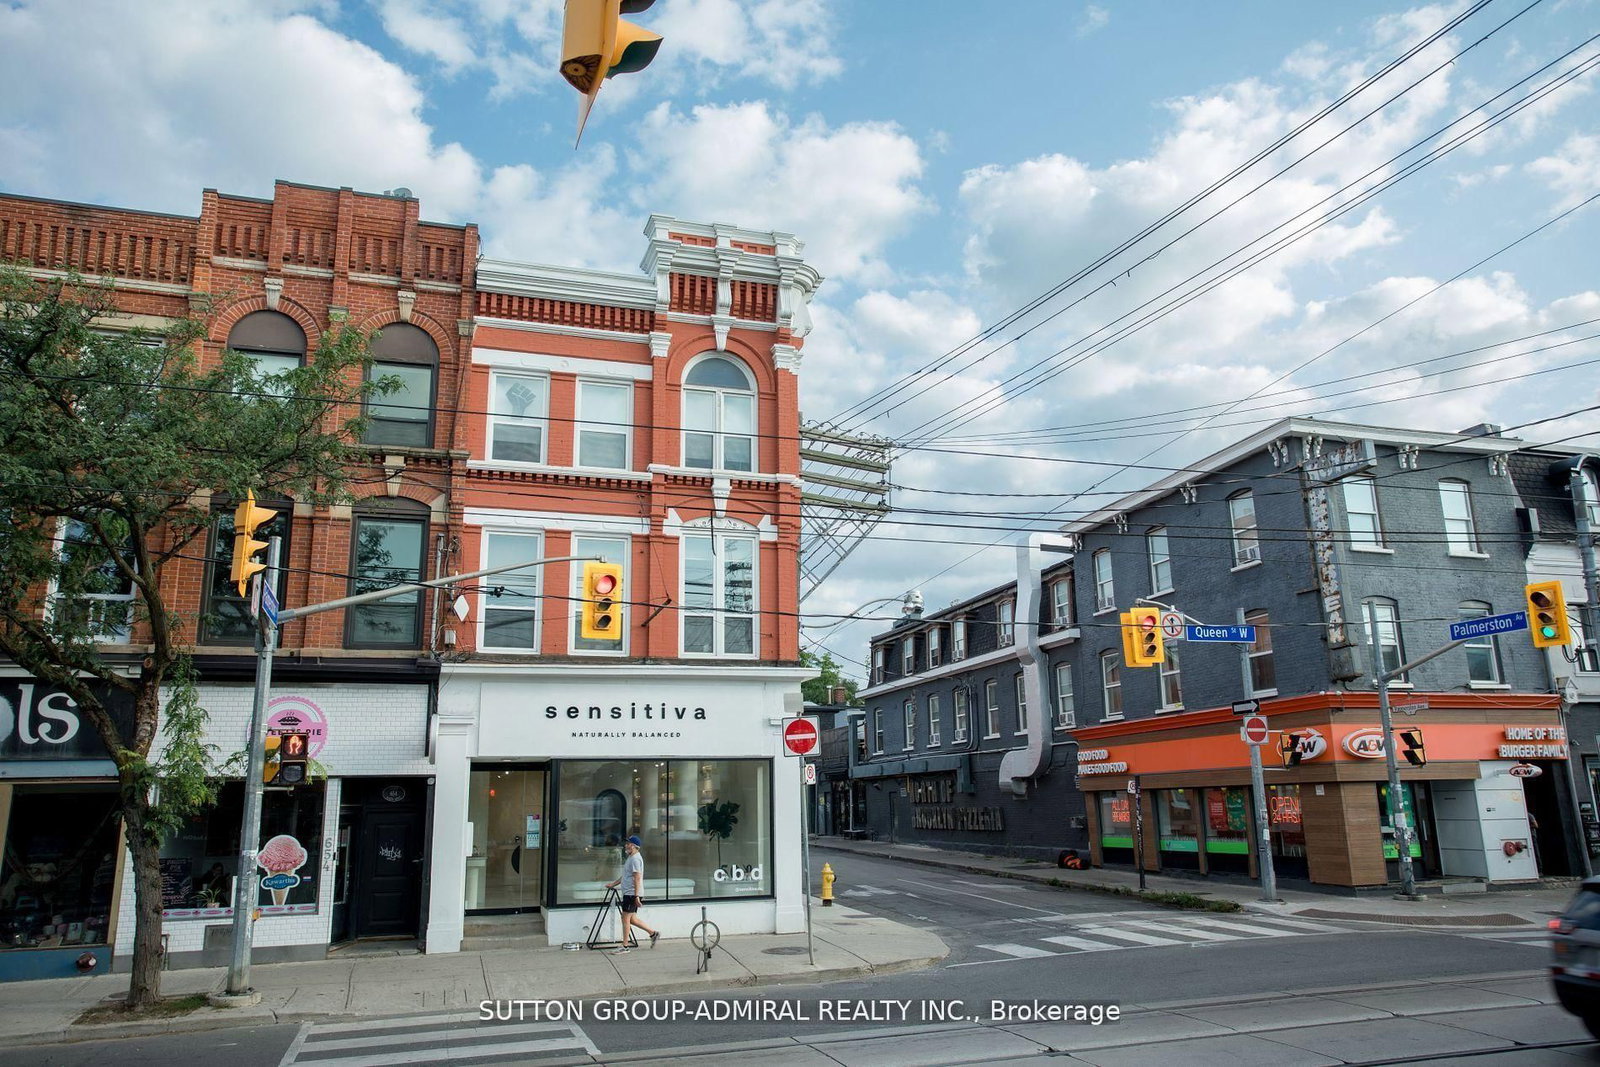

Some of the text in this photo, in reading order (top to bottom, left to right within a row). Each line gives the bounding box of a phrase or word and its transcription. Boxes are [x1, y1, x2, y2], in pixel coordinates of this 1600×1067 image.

[1195, 626, 1228, 639] Queen
[1239, 627, 1248, 638] W
[1453, 618, 1513, 637] Palmerston
[545, 702, 707, 720] sensitiva
[1506, 727, 1566, 740] HOME OF THE
[1077, 749, 1108, 762] GOOD FOOD
[1500, 744, 1569, 758] BURGER FAMILY
[1094, 763, 1110, 774] GOOD
[1110, 762, 1128, 772] FOOD
[1270, 796, 1300, 812] OPEN
[322, 838, 333, 872] 654
[713, 864, 763, 882] cbd
